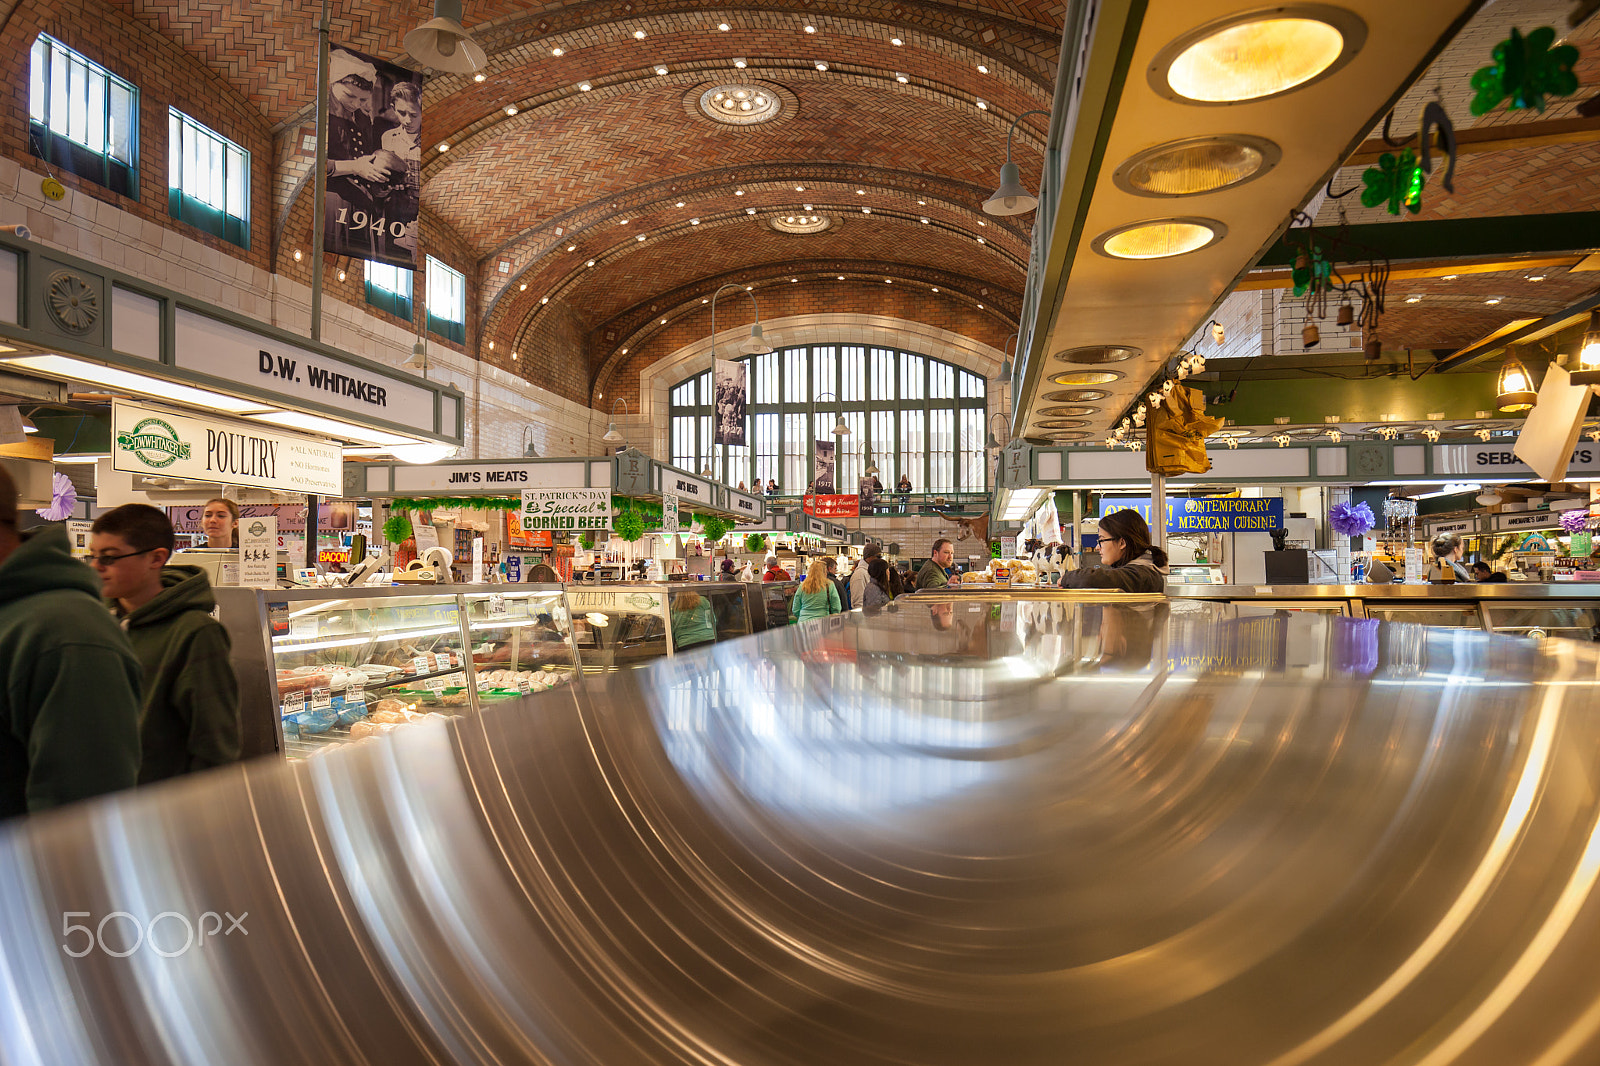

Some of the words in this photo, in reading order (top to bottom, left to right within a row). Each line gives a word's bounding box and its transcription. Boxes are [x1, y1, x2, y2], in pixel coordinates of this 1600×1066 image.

[335, 207, 406, 238] 1940
[259, 349, 301, 383] D.W.
[307, 365, 387, 407] WHITAKER
[719, 426, 743, 436] 1927
[206, 428, 279, 479] POULTRY
[308, 448, 336, 459] NATURAL
[1476, 450, 1592, 465] SEBA'S
[294, 460, 304, 469] NO
[294, 476, 304, 484] NO
[448, 471, 481, 483] JIM'S
[486, 470, 528, 482] MEATS
[630, 476, 637, 488] 7
[1013, 469, 1019, 482] 7
[524, 492, 537, 500] ST.
[540, 491, 588, 500] PATRICK'S
[589, 491, 608, 500] DAY
[543, 501, 596, 517] Special
[523, 516, 575, 529] CORNED
[578, 516, 609, 529] BEEF
[1178, 516, 1230, 530] MEXICAN
[1234, 516, 1276, 530] CUISINE
[1508, 516, 1535, 525] ANNEMARIE'S
[319, 551, 348, 563] BACON
